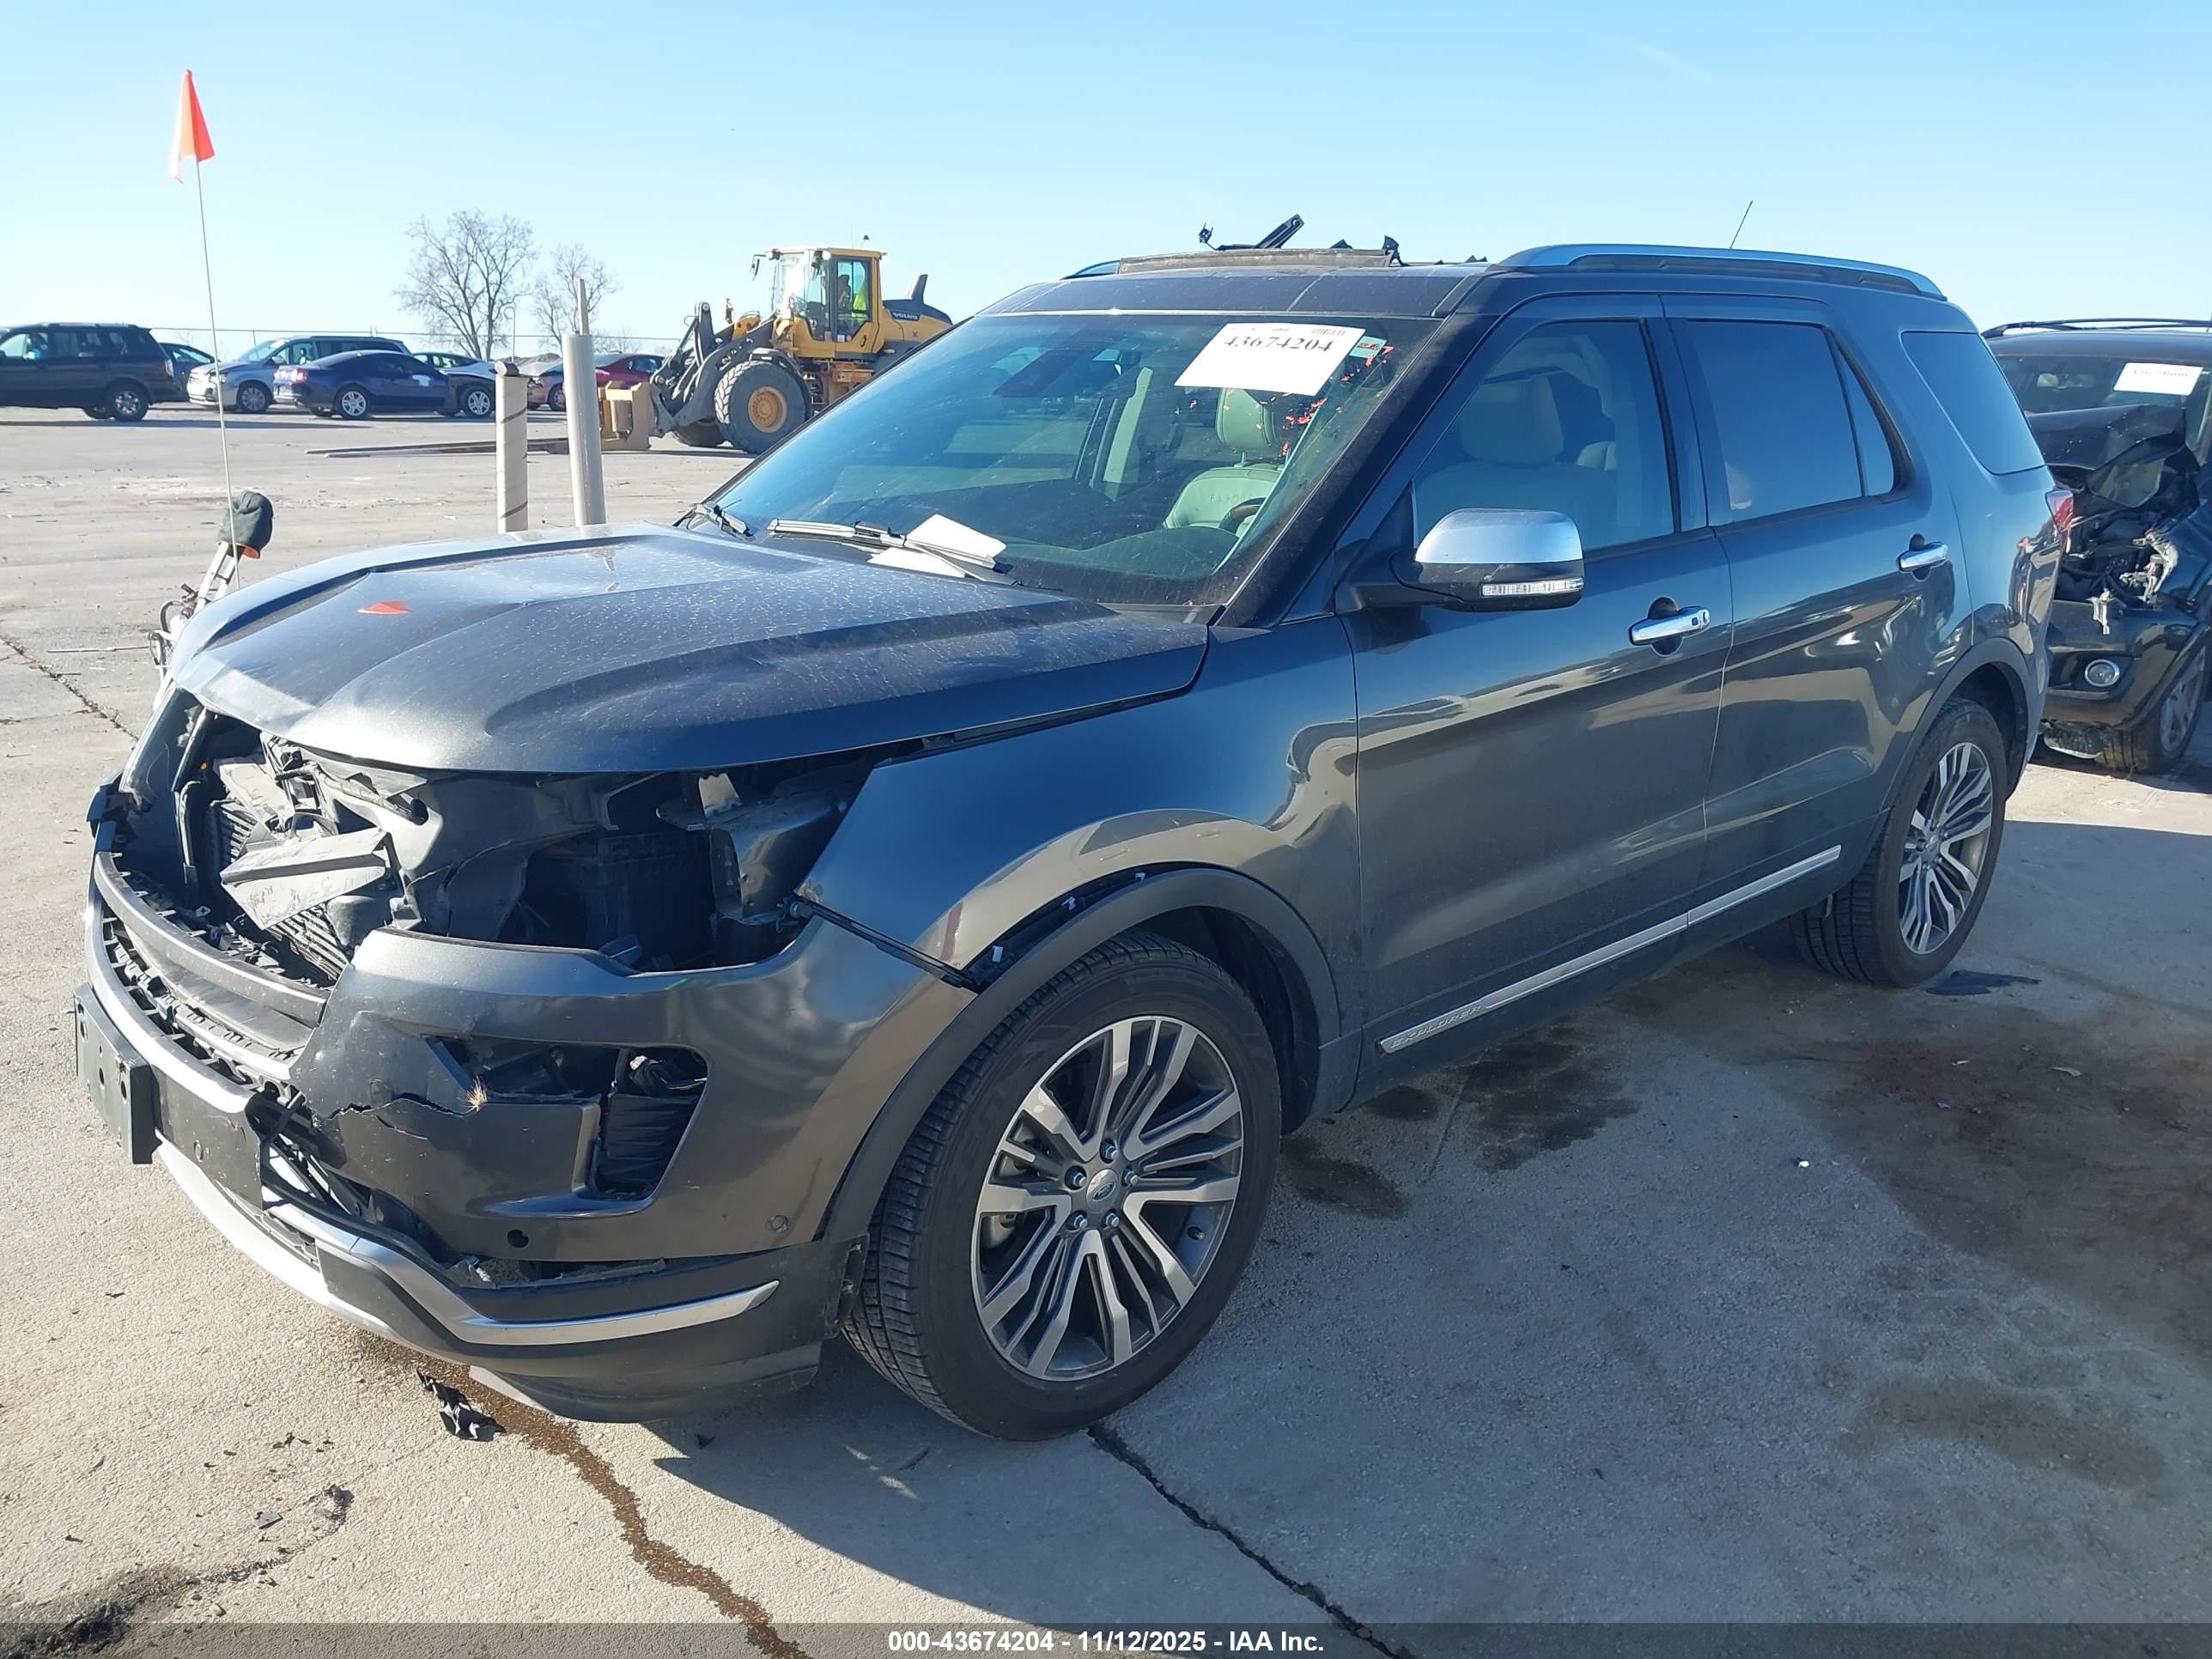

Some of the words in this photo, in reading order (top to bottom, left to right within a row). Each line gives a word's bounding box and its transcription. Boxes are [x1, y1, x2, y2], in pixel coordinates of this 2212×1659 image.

[892, 312, 918, 320] VOLVO
[1224, 336, 1334, 352] 43674204
[1389, 1005, 1481, 1049] EXPLORER
